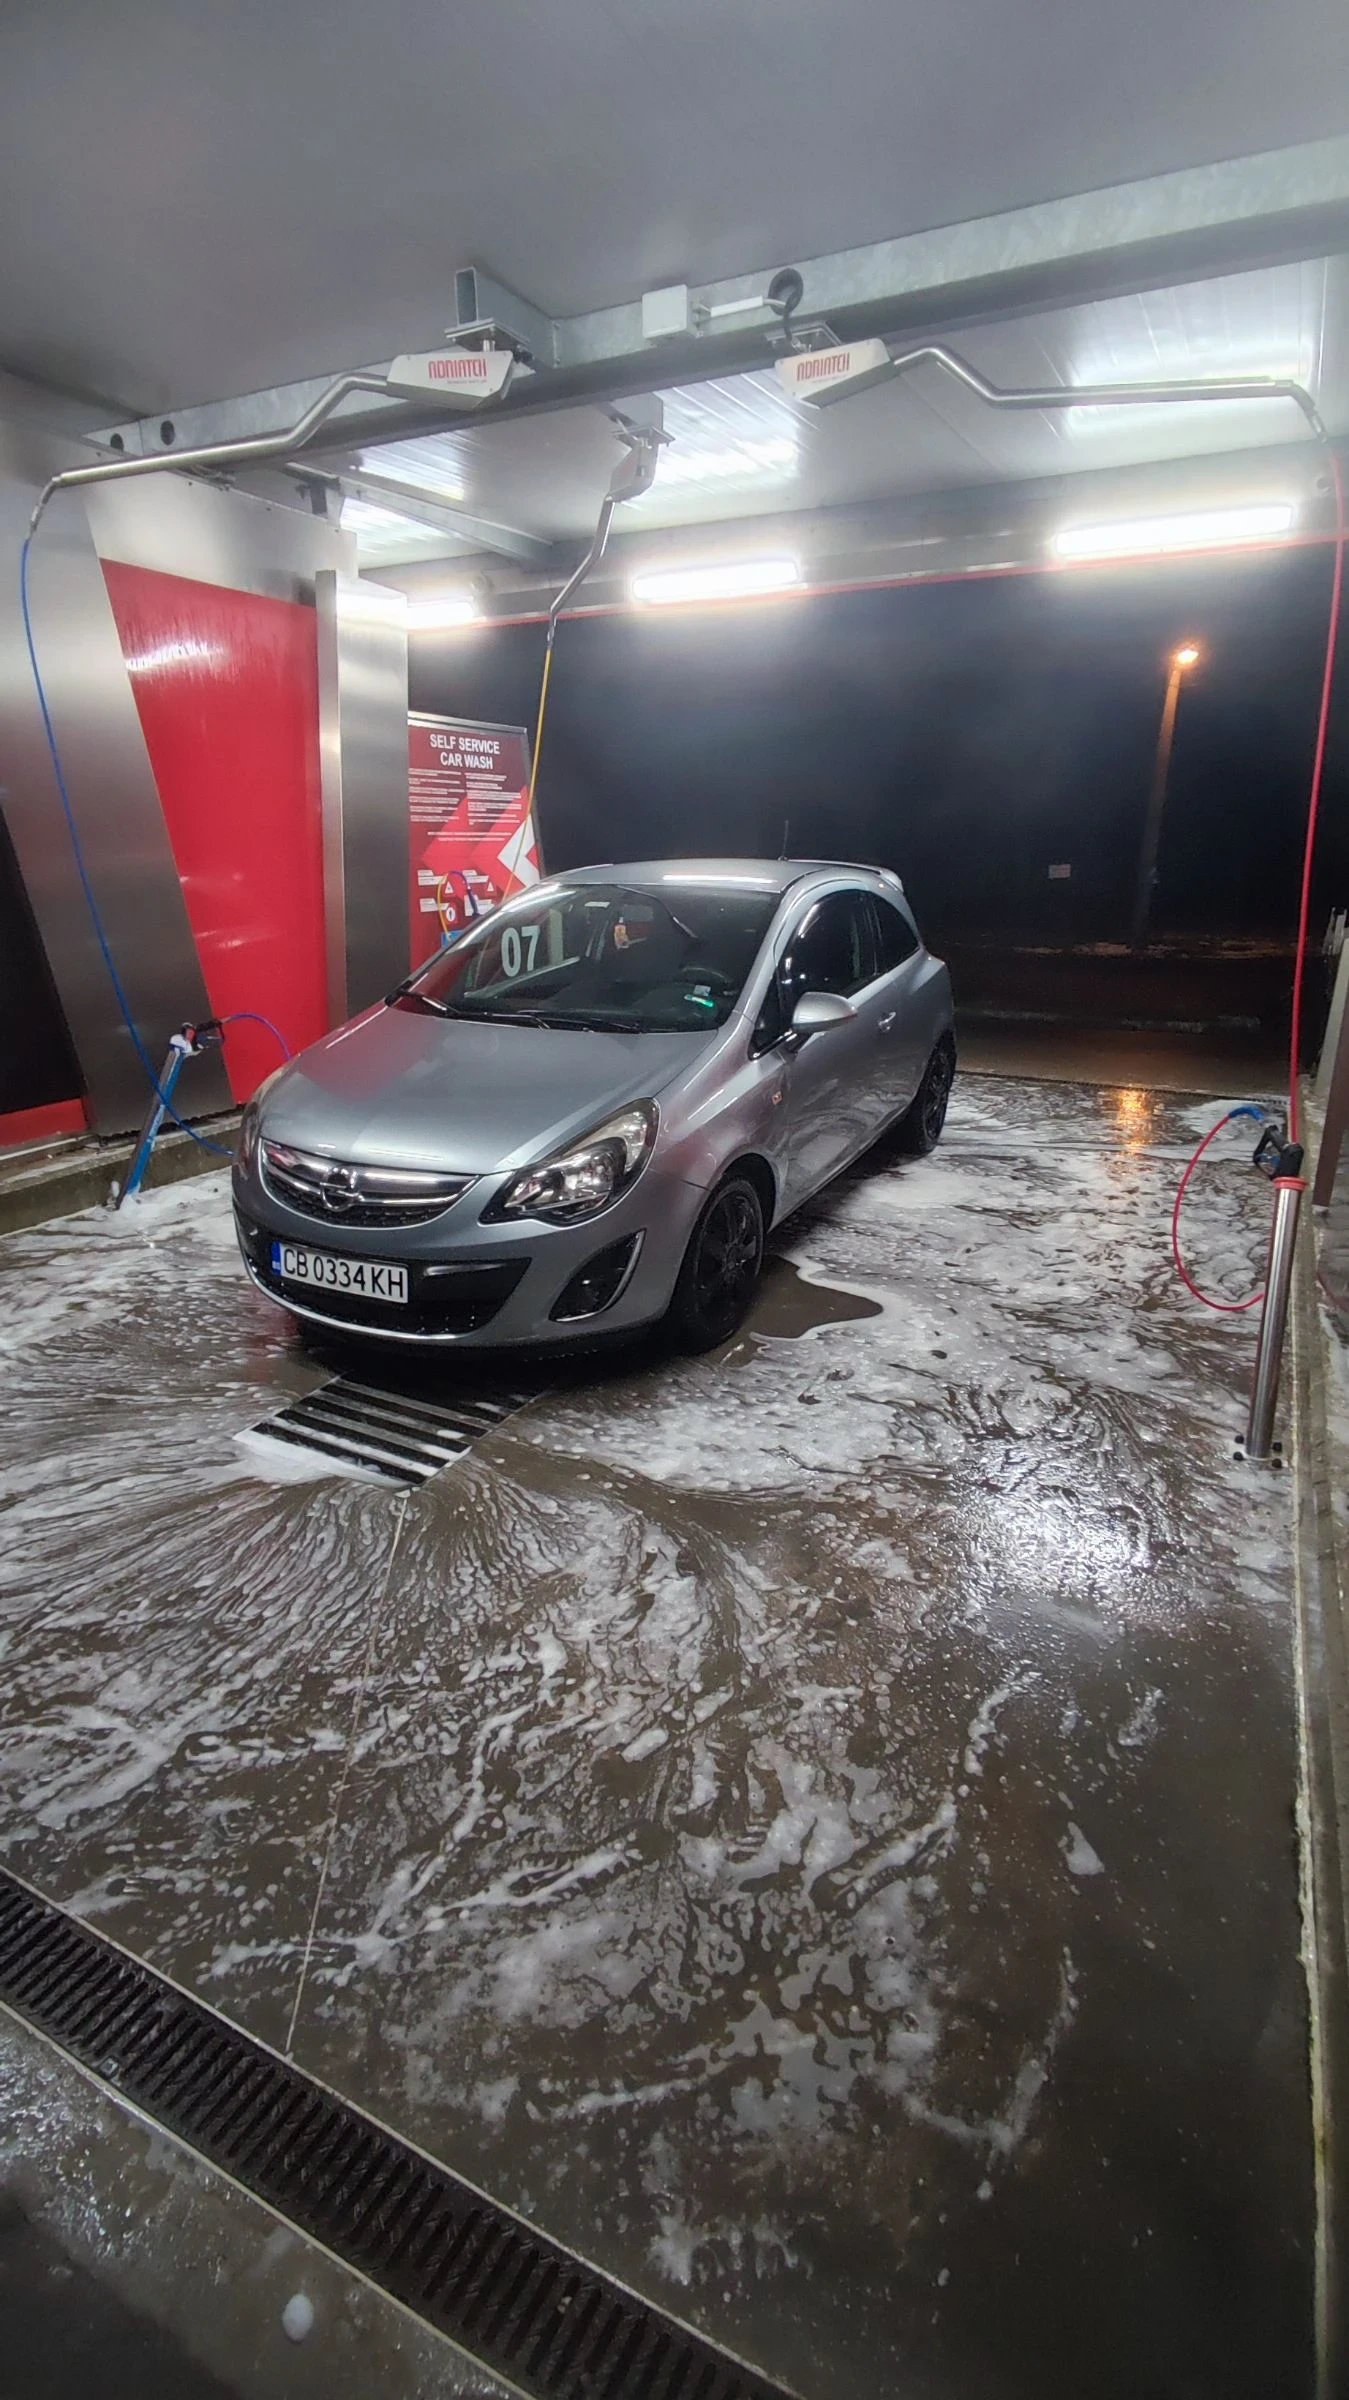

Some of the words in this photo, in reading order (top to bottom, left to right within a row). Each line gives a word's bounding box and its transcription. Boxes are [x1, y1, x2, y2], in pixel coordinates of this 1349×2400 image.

[429, 733, 456, 749] SELF
[458, 737, 500, 754] SERVICE
[440, 752, 462, 767] CAR
[464, 754, 493, 770] WASH
[501, 925, 540, 977] 07
